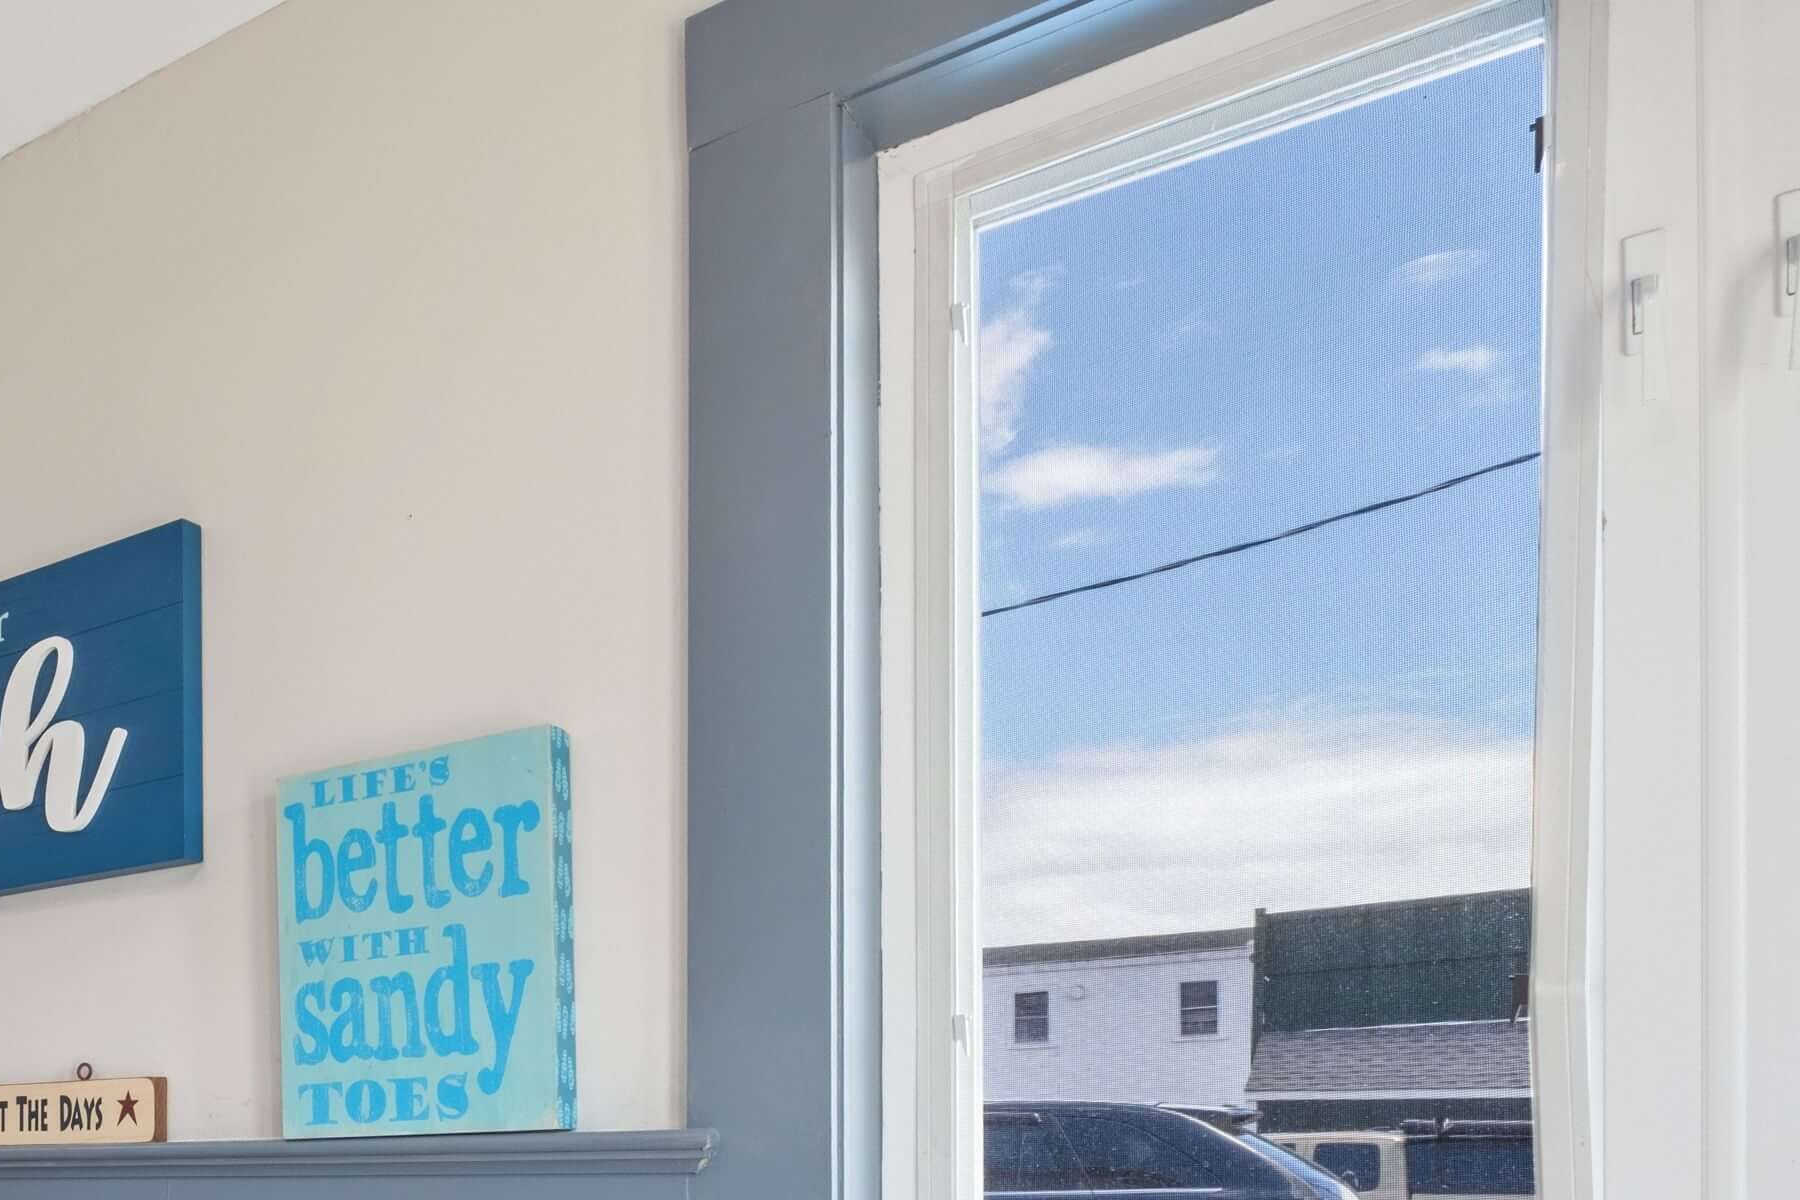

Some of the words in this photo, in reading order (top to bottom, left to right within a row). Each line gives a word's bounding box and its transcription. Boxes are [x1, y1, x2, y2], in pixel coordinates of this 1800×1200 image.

[311, 755, 450, 808] LIFE'S
[284, 794, 541, 925] better
[298, 926, 431, 968] WITH
[293, 923, 534, 1095] sandy
[16, 1095, 48, 1131] THE
[59, 1094, 103, 1131] DAYS
[297, 1071, 470, 1126] TOES
